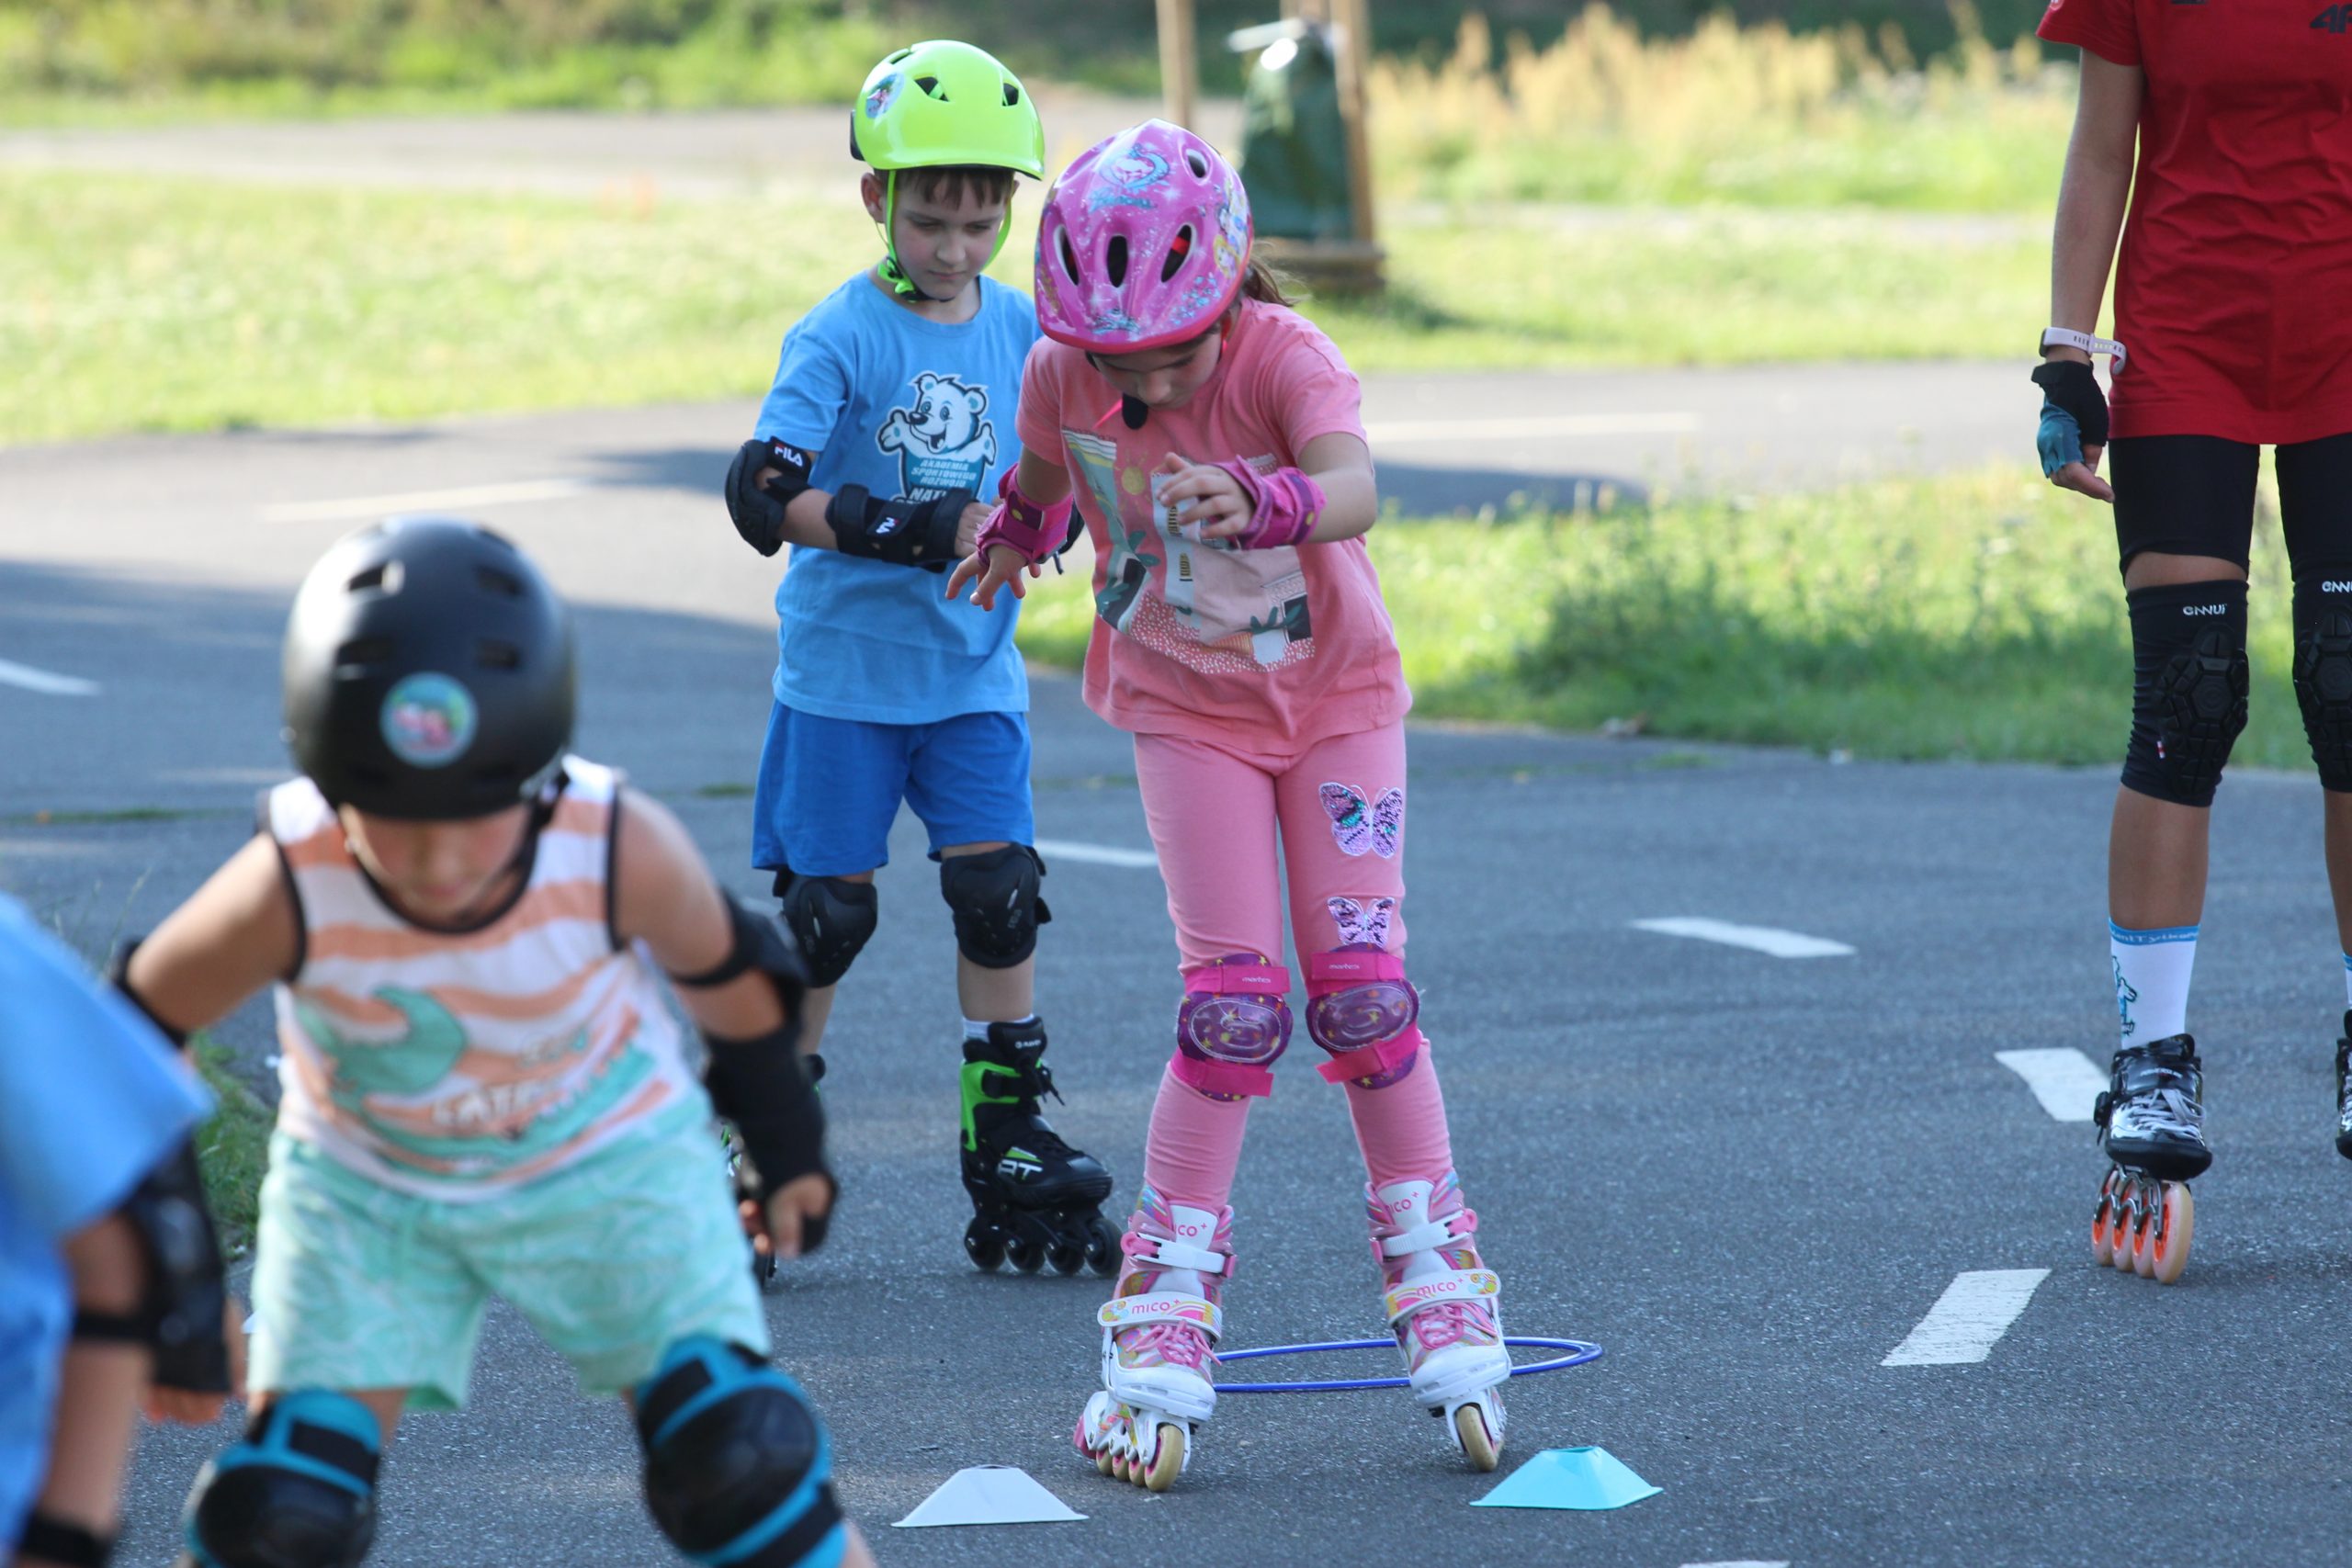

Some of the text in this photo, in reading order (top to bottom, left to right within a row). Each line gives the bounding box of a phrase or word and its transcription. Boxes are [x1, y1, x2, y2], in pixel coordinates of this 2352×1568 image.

[775, 443, 803, 467] FILA
[920, 459, 969, 471] AKADEMIA
[911, 467, 977, 480] SPORTOWEGO
[920, 476, 967, 488] ROZWOJU
[909, 488, 947, 502] NAT
